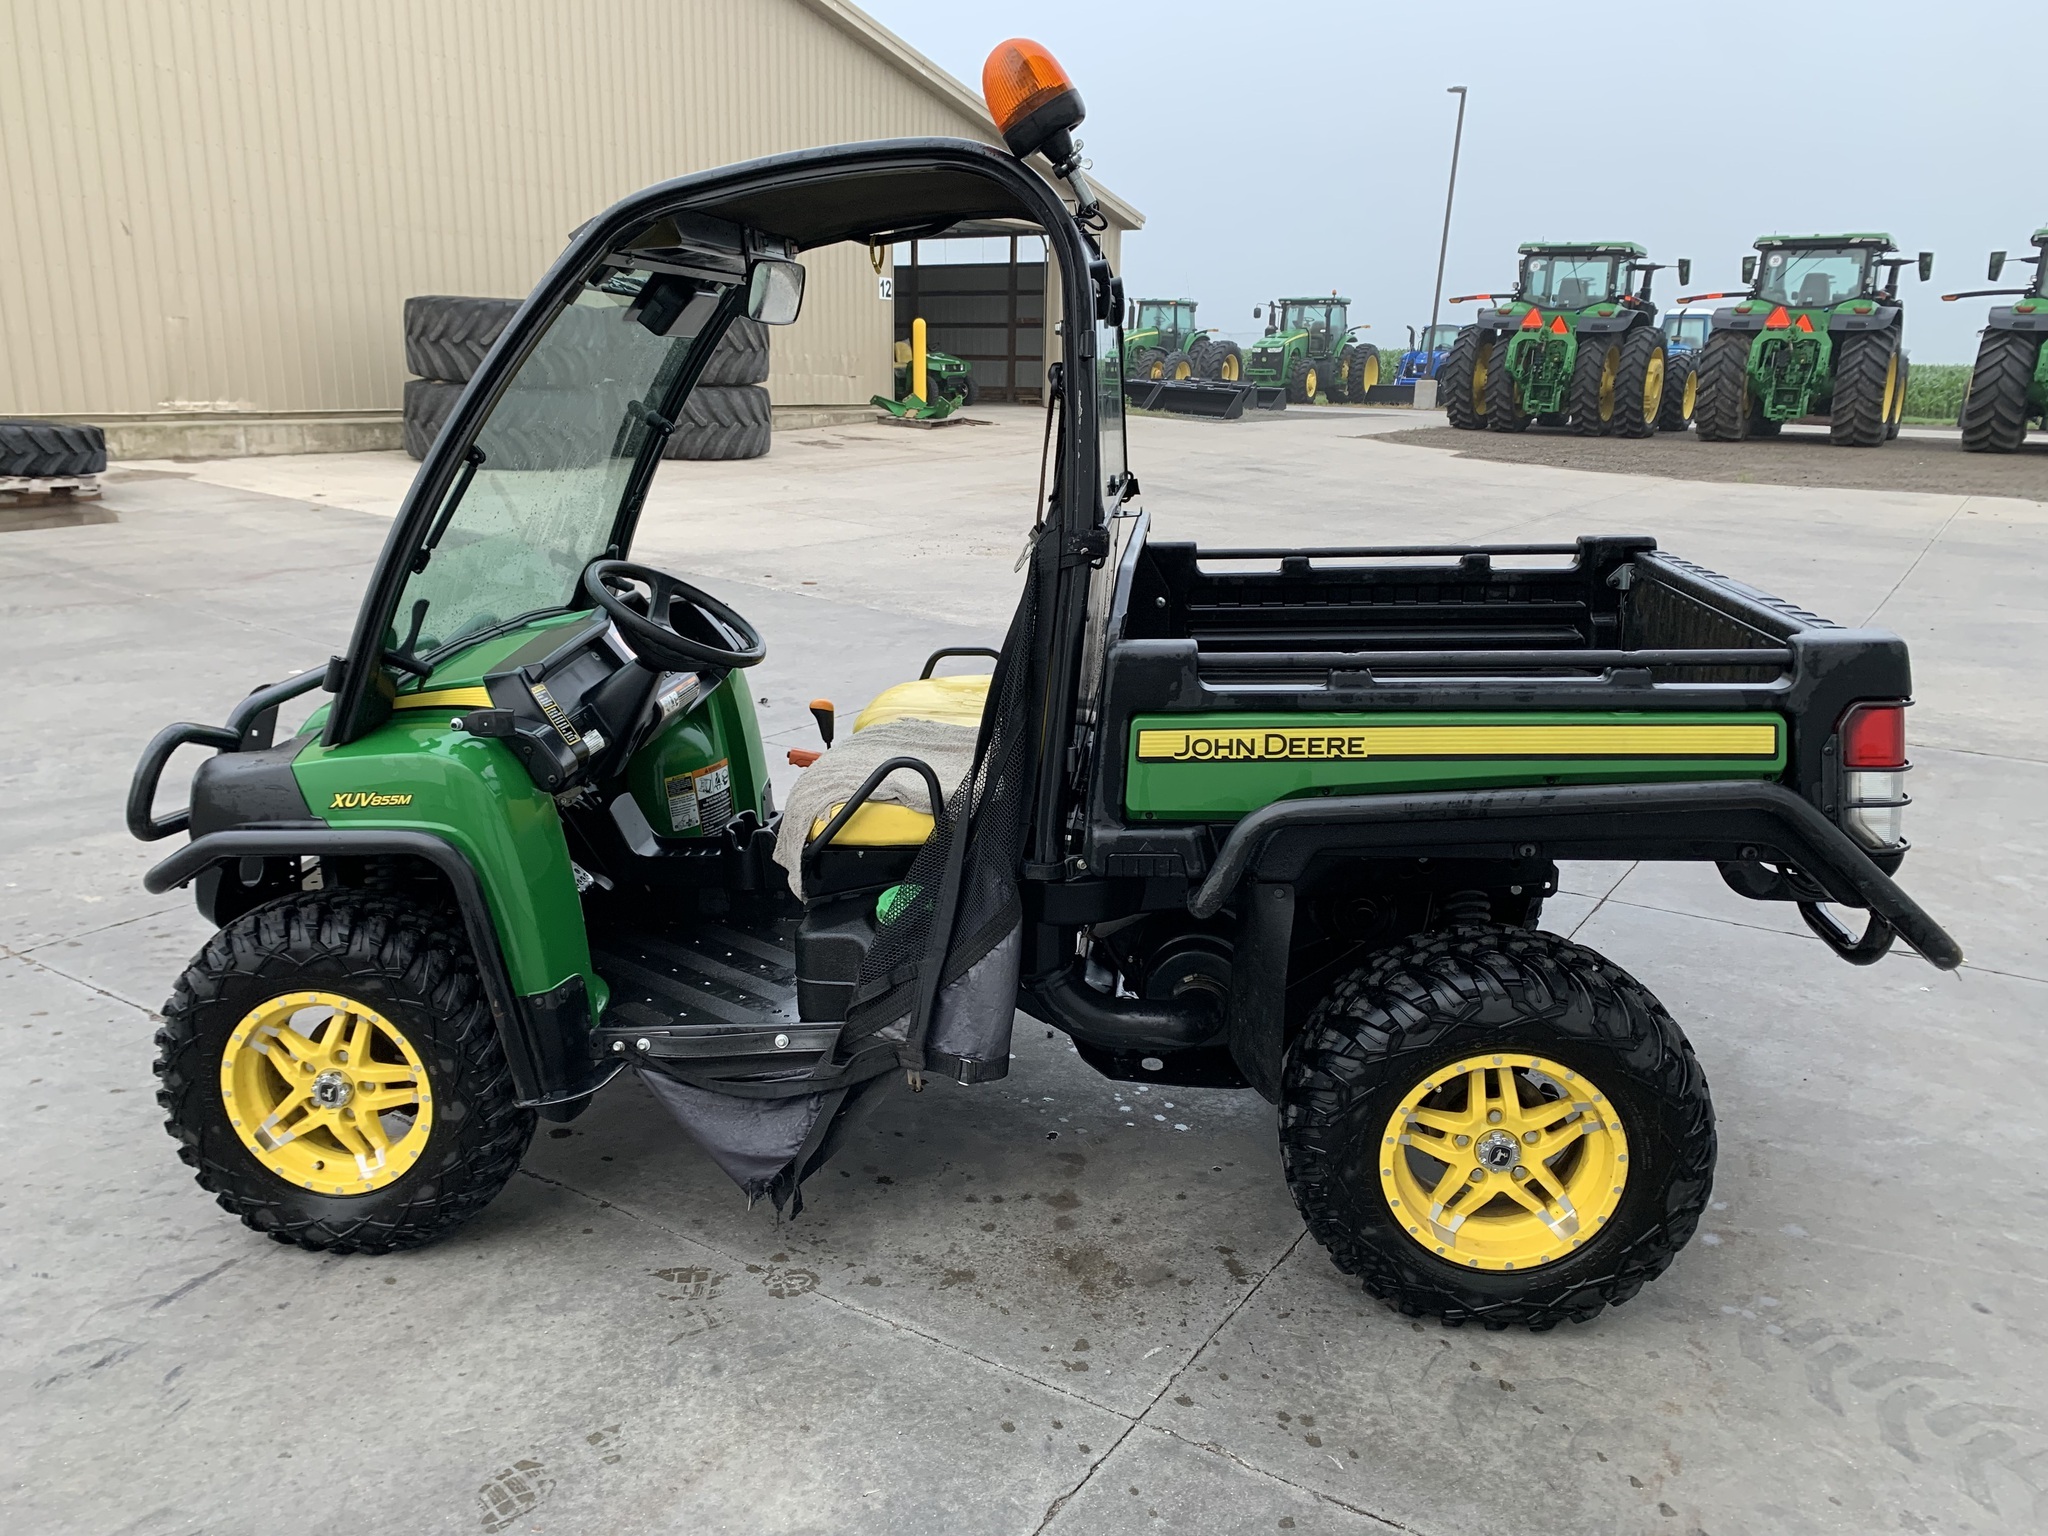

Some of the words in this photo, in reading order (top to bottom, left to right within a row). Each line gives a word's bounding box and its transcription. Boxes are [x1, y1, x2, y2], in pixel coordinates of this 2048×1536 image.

[880, 279, 891, 297] 12
[1174, 734, 1256, 757] JOHN
[1264, 733, 1366, 756] DEERE
[330, 793, 412, 808] XUV855M
